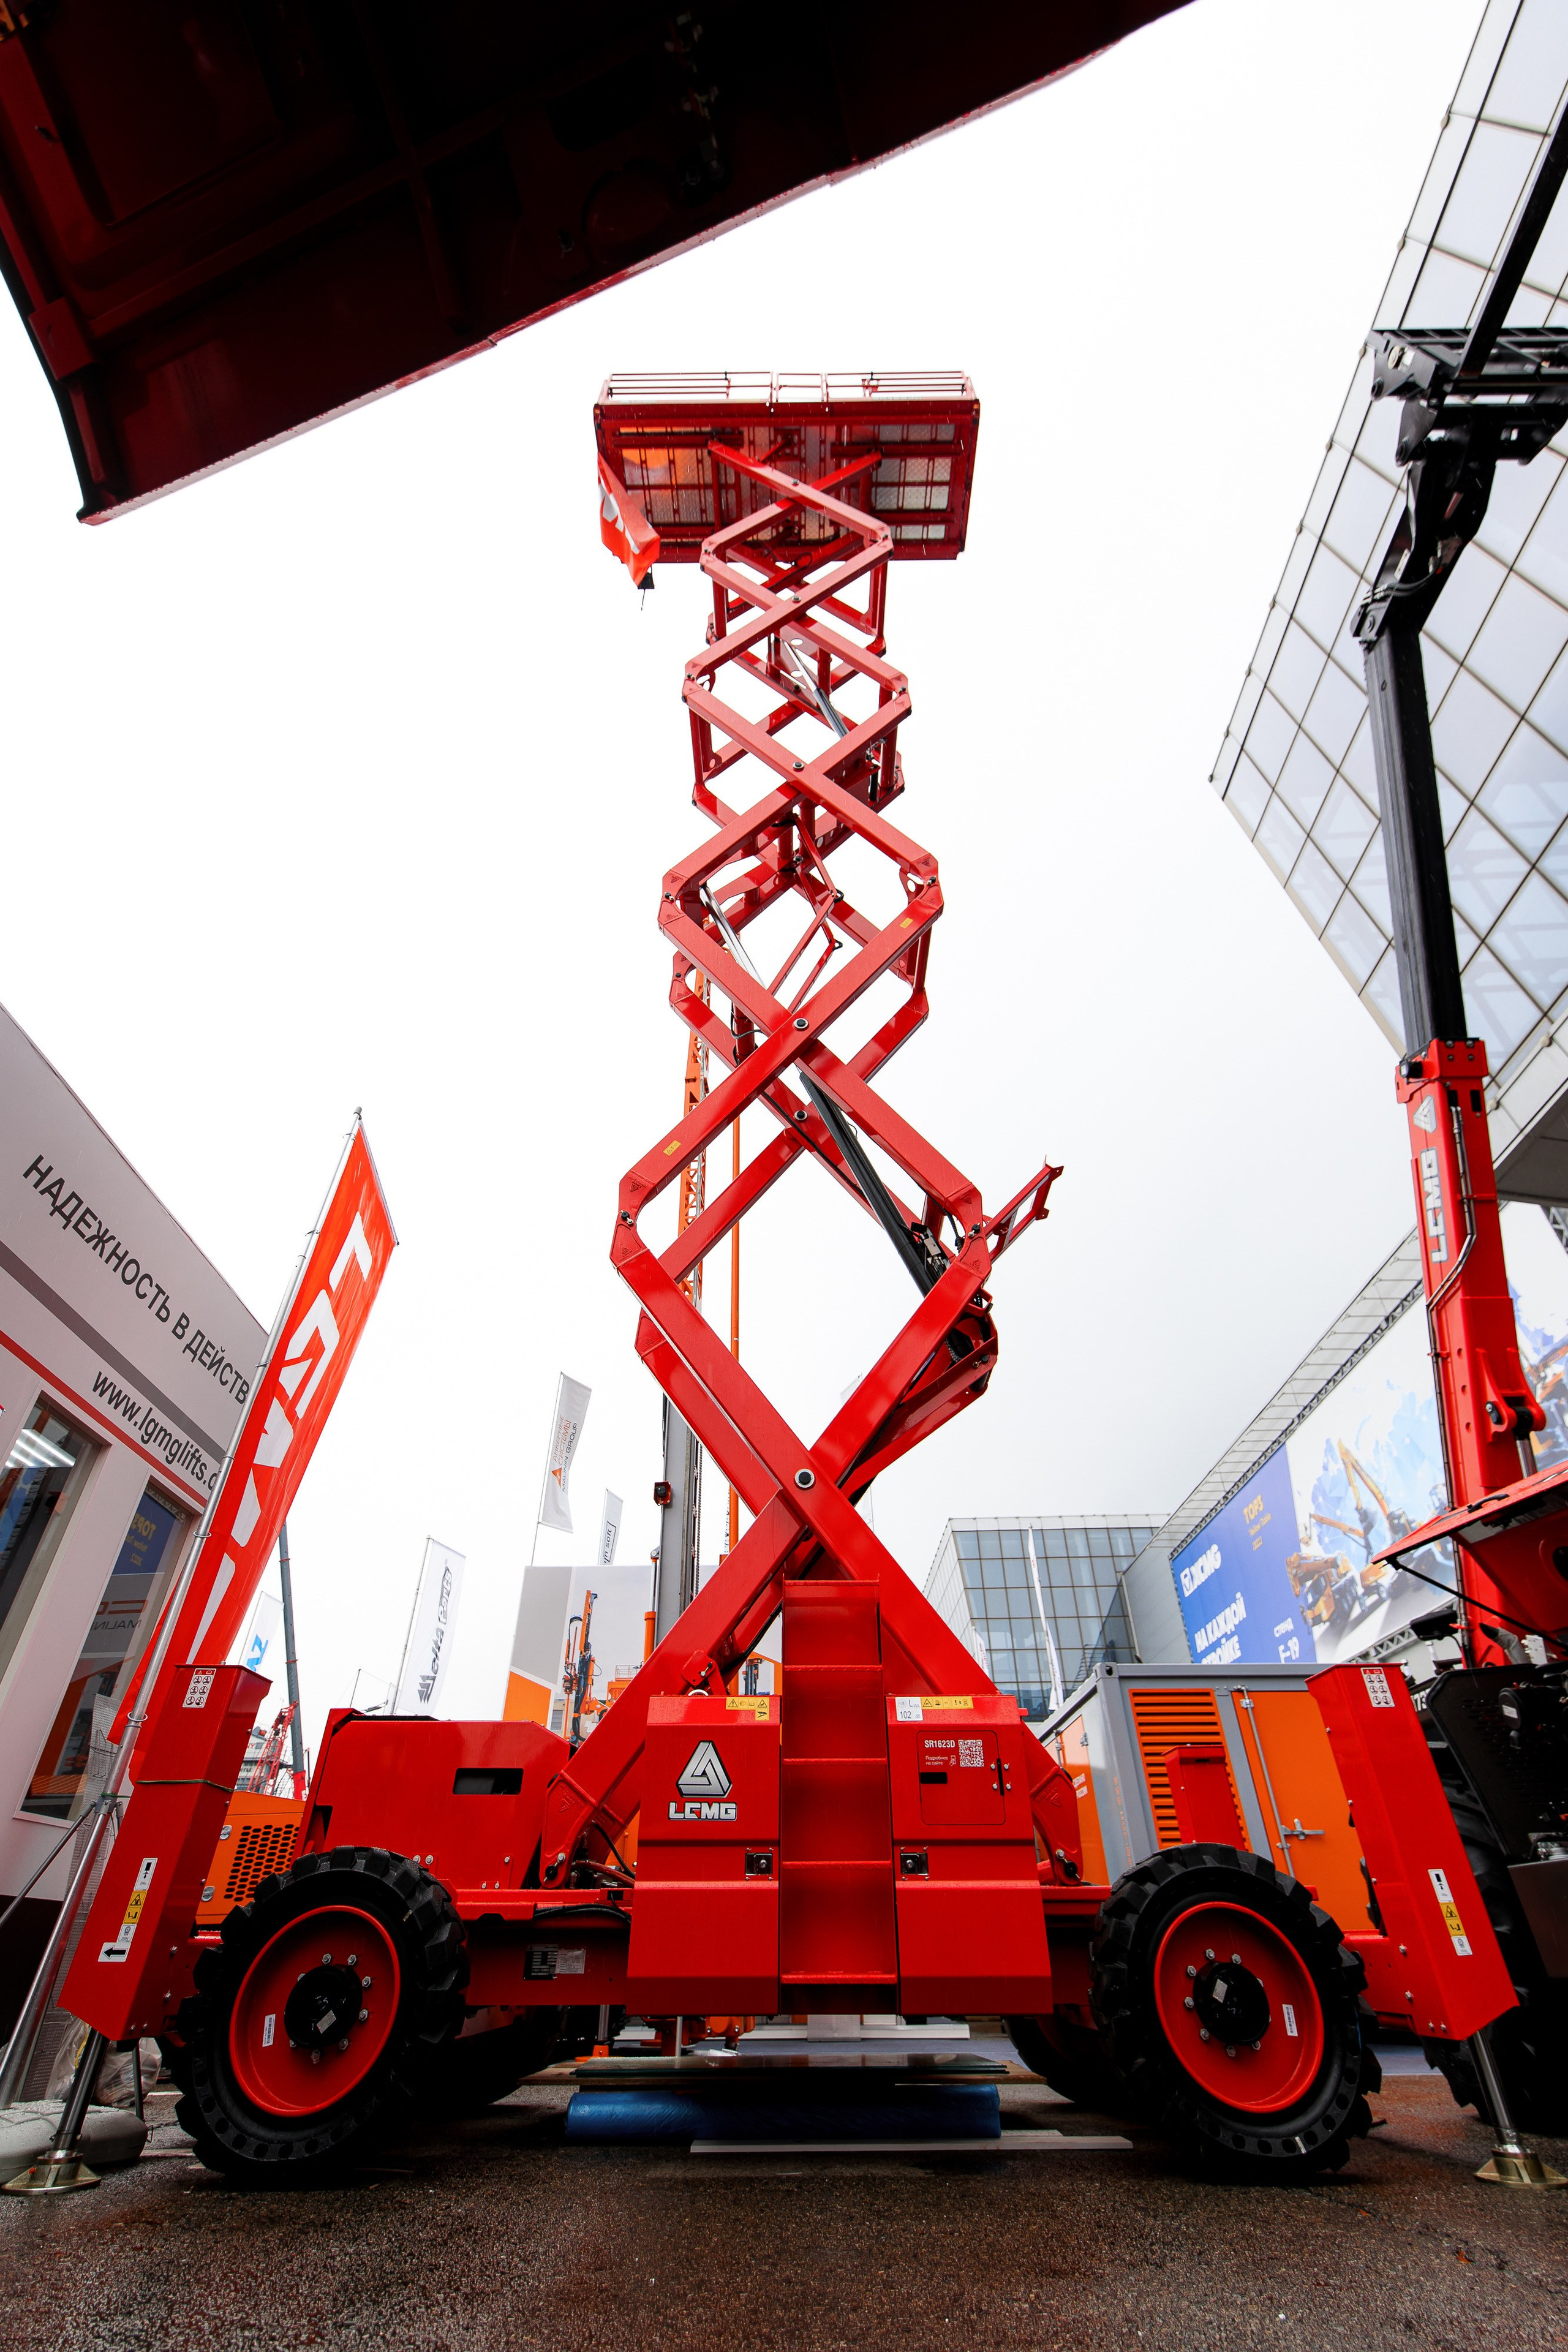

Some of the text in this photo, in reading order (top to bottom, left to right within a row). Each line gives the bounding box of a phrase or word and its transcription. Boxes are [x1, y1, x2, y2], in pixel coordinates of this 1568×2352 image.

[22, 1155, 170, 1325] НАДЕЖНОСТЬ
[171, 1312, 190, 1340] В
[558, 1419, 571, 1466] СИСТЕМЫ
[566, 1422, 577, 1453] GROUP
[1194, 1591, 1247, 1653] НА КАЖДОЙ
[900, 1710, 912, 1719] 102
[924, 1740, 956, 1748] SR1623D
